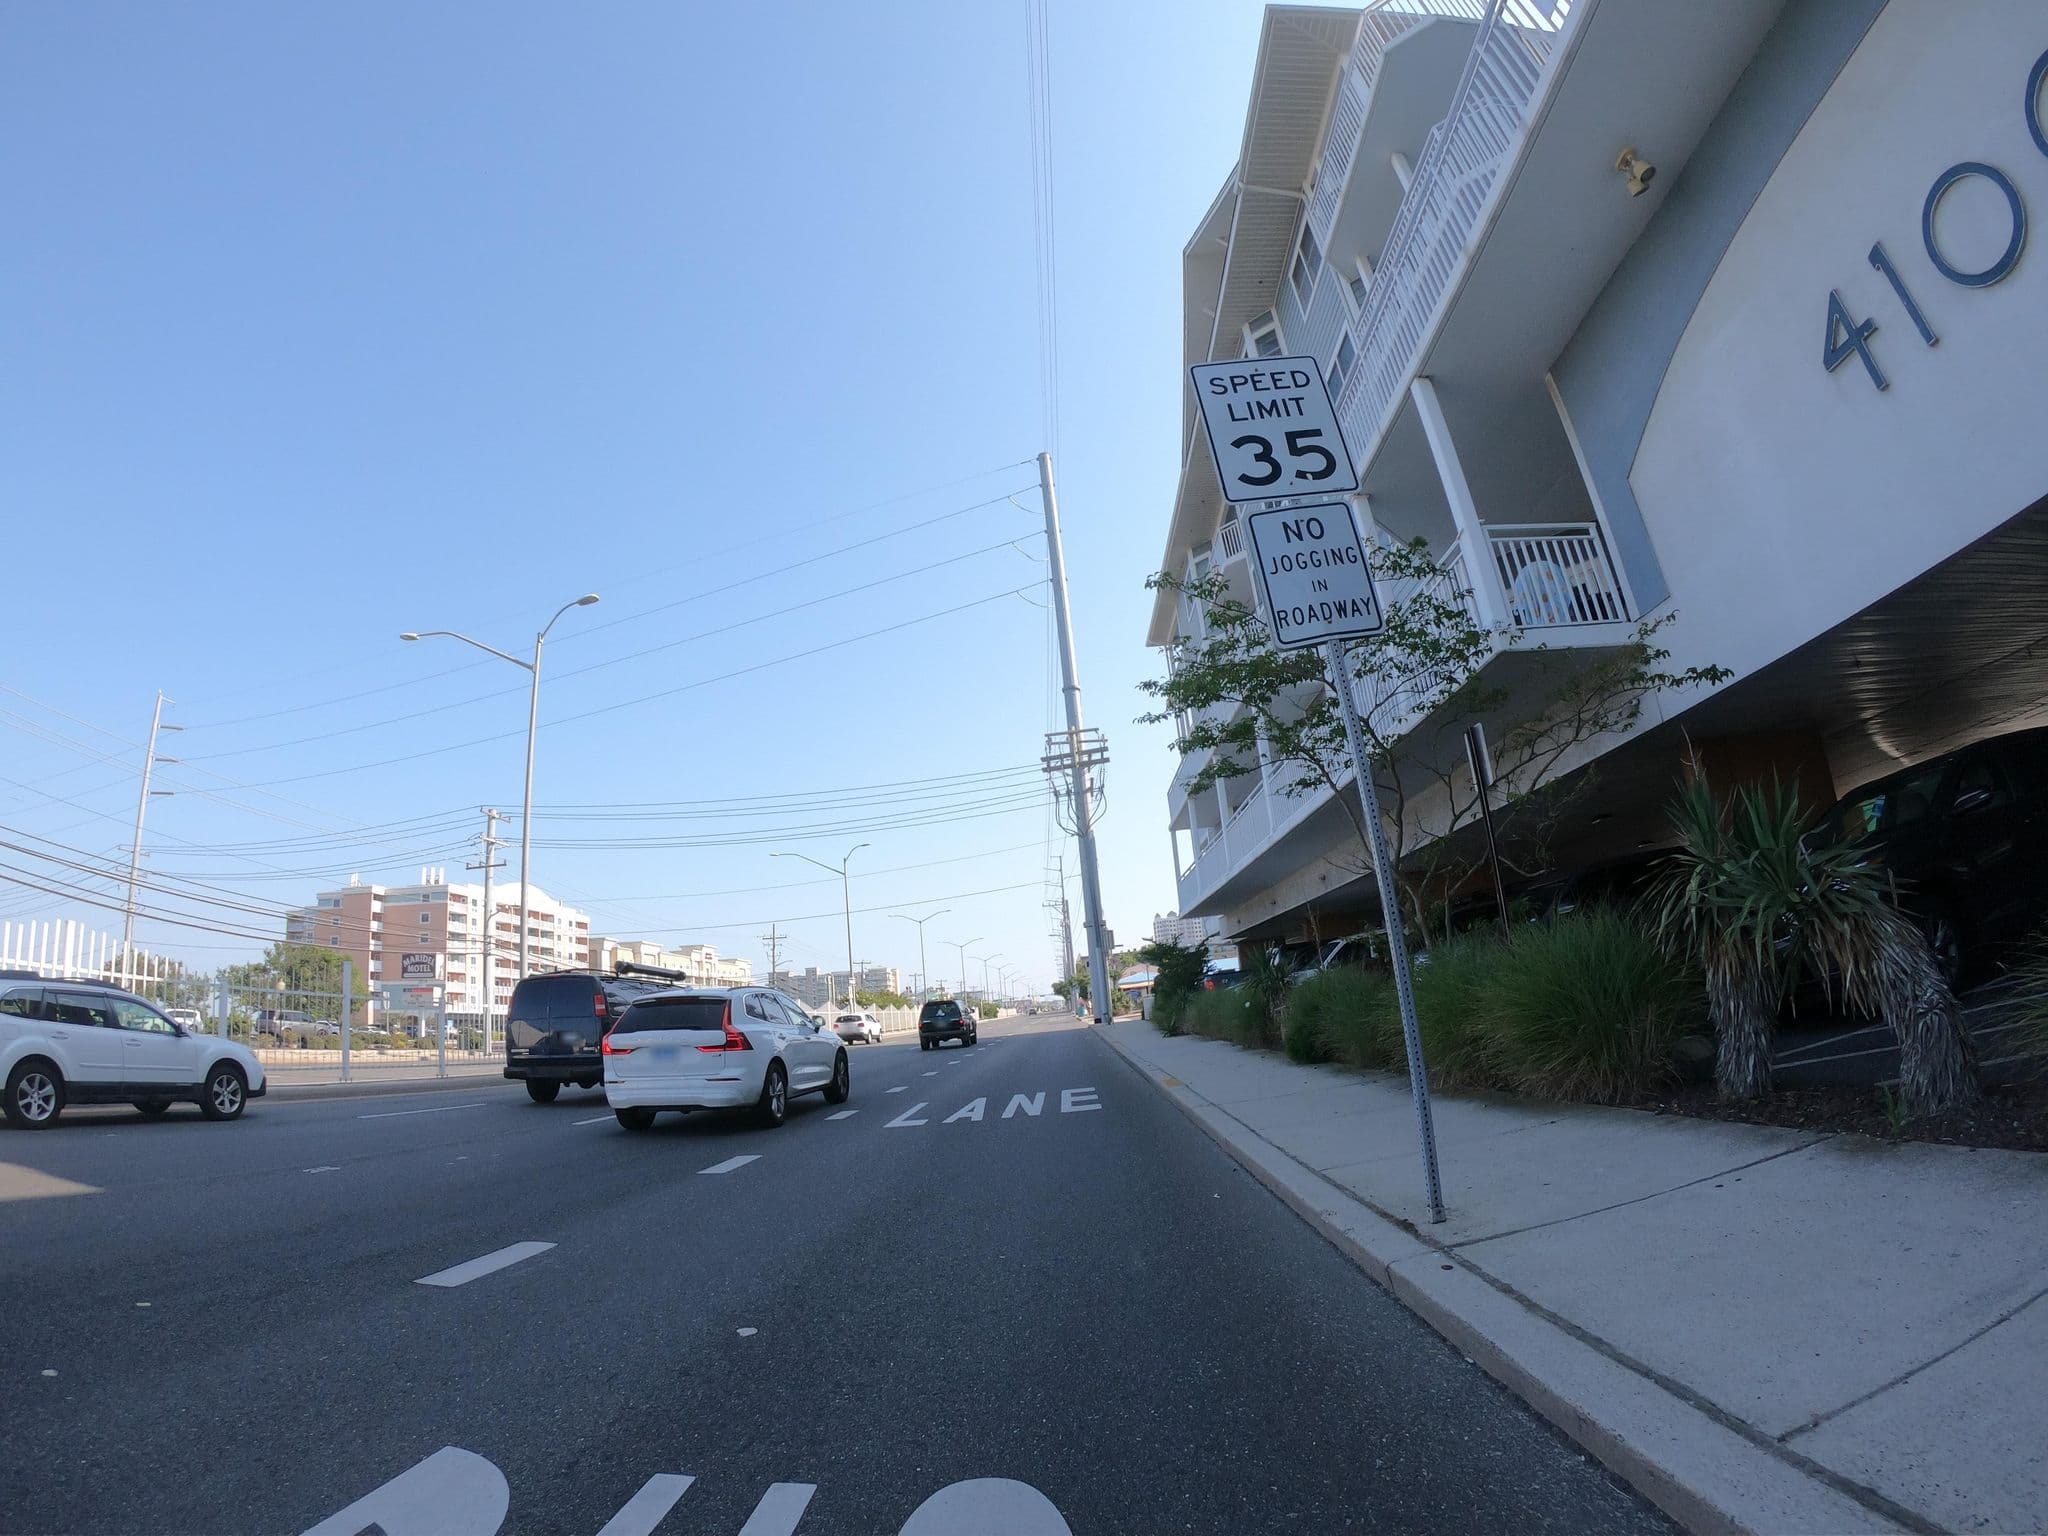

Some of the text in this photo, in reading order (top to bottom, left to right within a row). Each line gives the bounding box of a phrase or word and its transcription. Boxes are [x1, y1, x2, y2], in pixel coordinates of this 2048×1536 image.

[1824, 48, 2048, 391] 410
[1209, 370, 1311, 395] SPEED
[1227, 397, 1305, 422] LIMIT
[1230, 428, 1337, 486] 35
[1282, 517, 1325, 543] NO
[1270, 546, 1358, 575] JOGGING
[1311, 578, 1329, 592] IN
[1276, 597, 1373, 630] ROADWAY
[407, 964, 431, 973] MOTEL
[882, 1086, 1103, 1128] LANE
